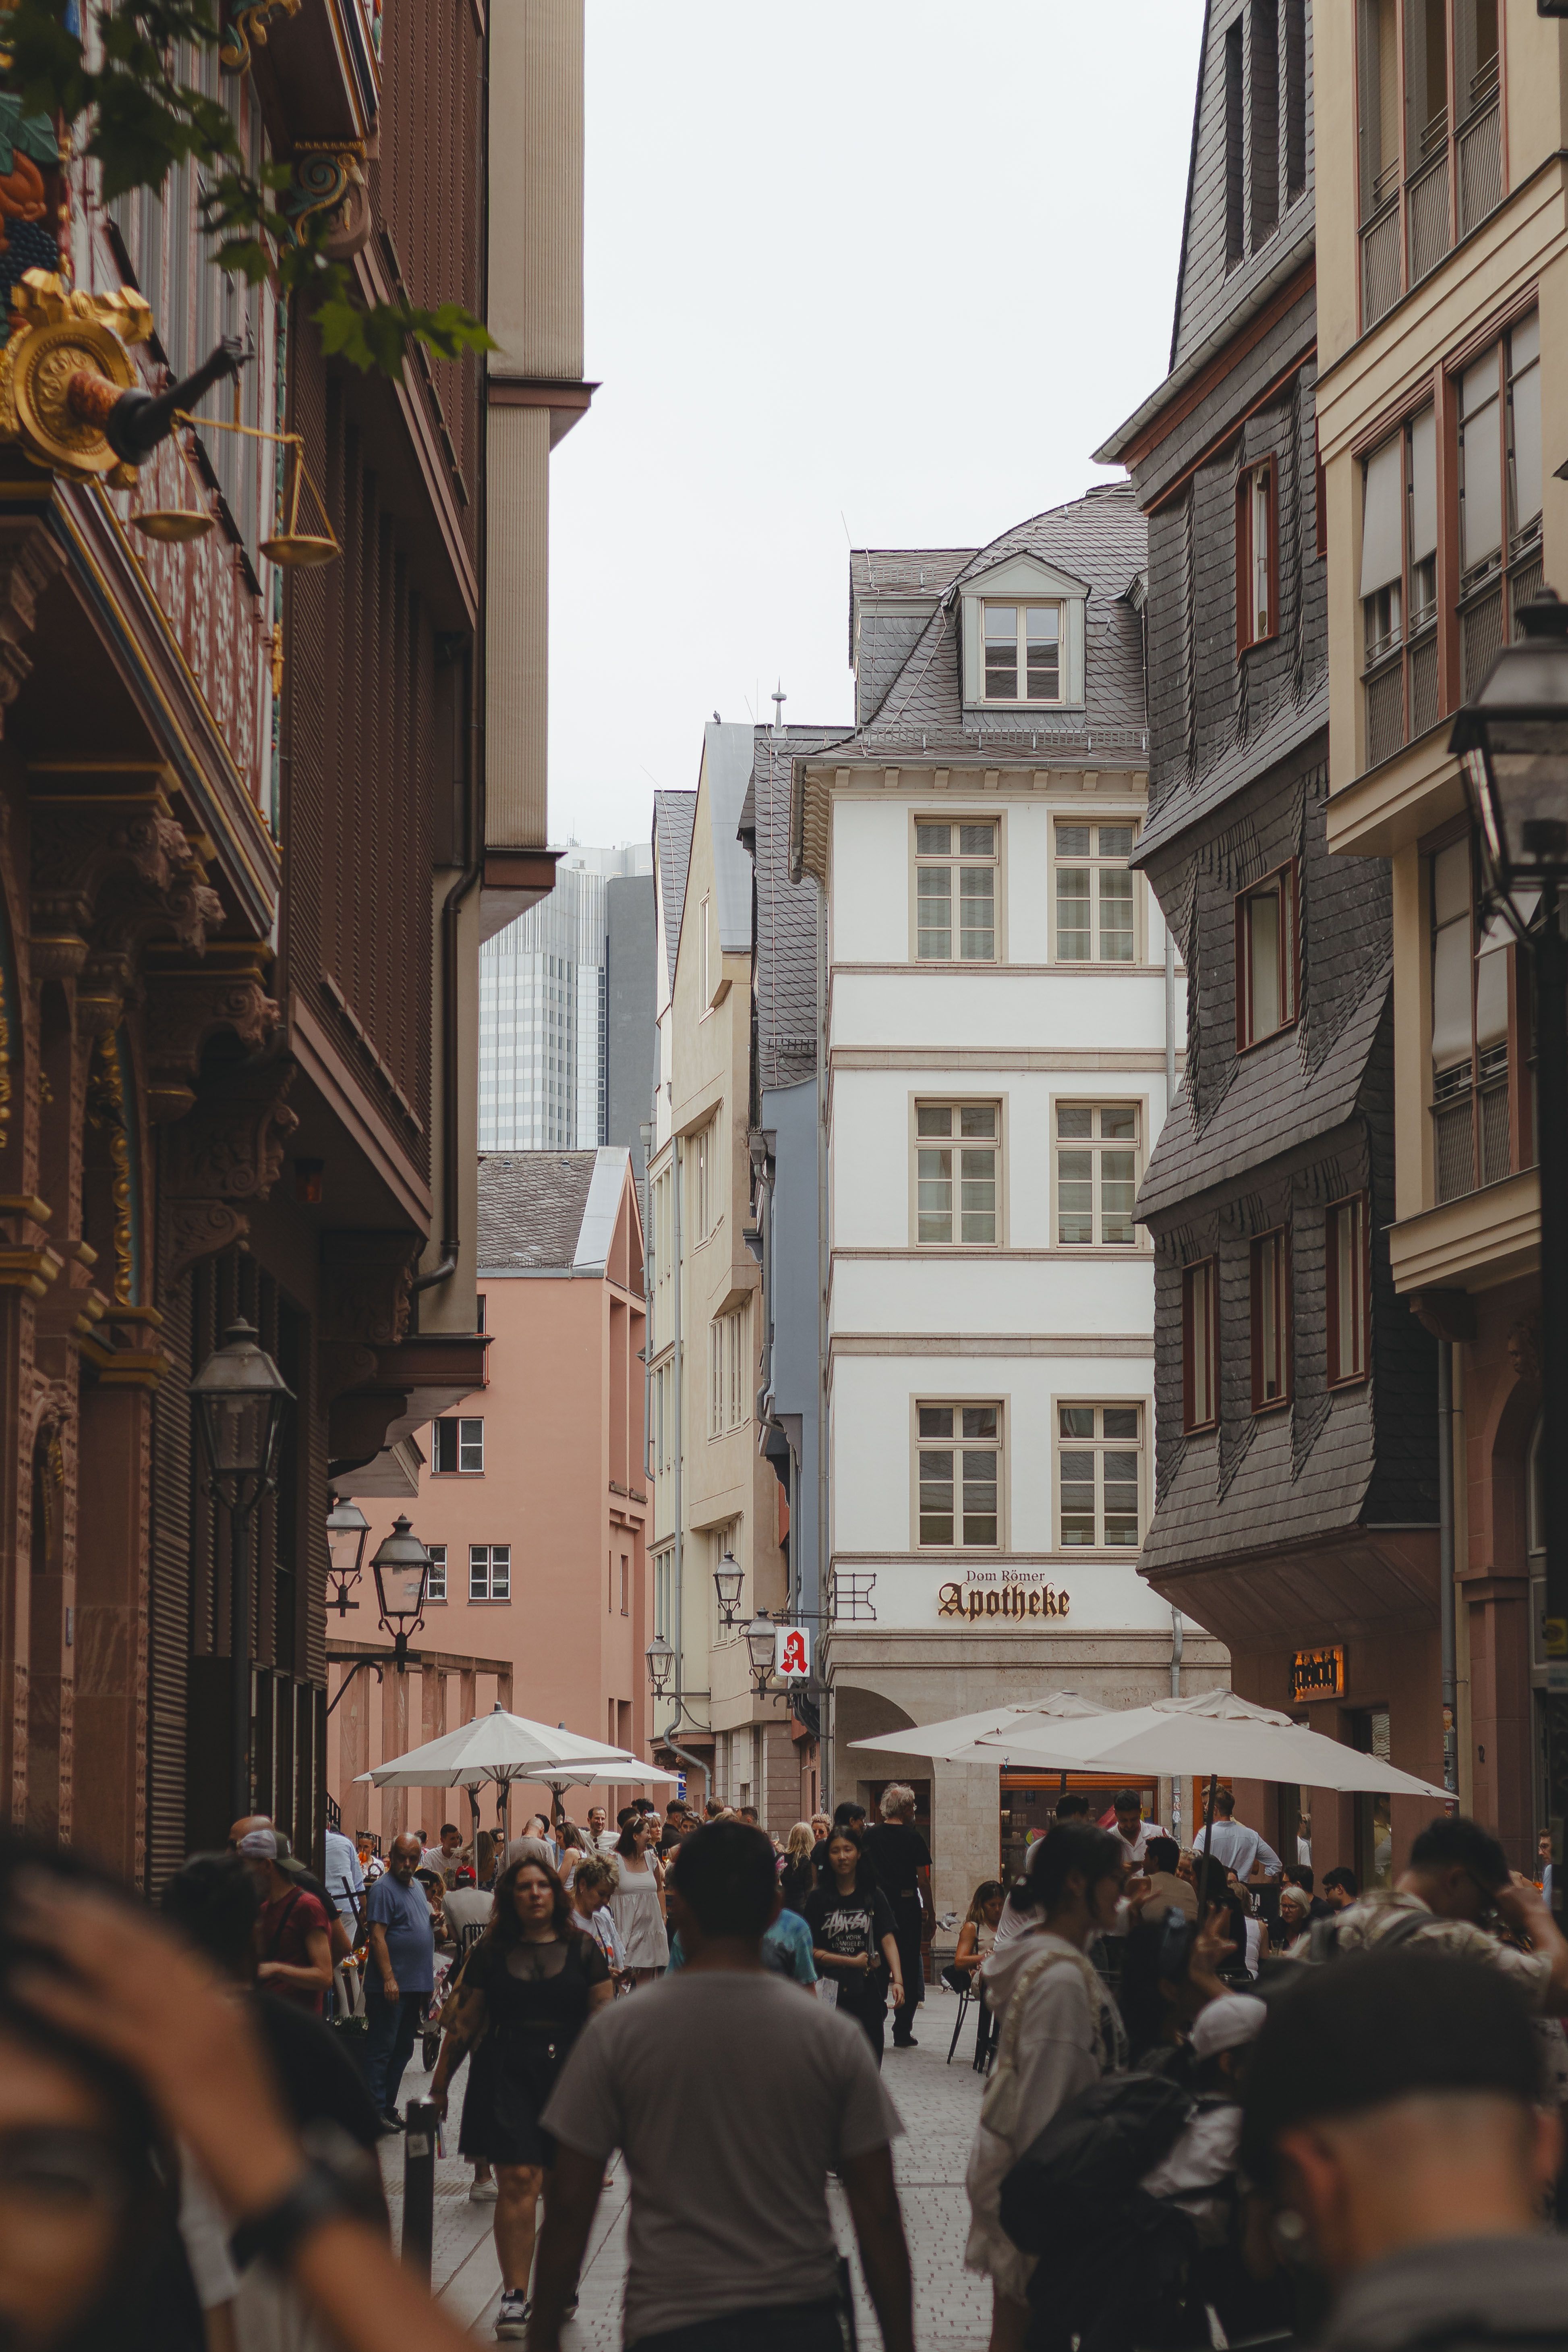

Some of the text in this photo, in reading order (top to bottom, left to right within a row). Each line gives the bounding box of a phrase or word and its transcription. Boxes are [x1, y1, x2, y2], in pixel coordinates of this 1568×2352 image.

[967, 1569, 1045, 1581] Dom Römer
[938, 1582, 1070, 1623] Apotheke
